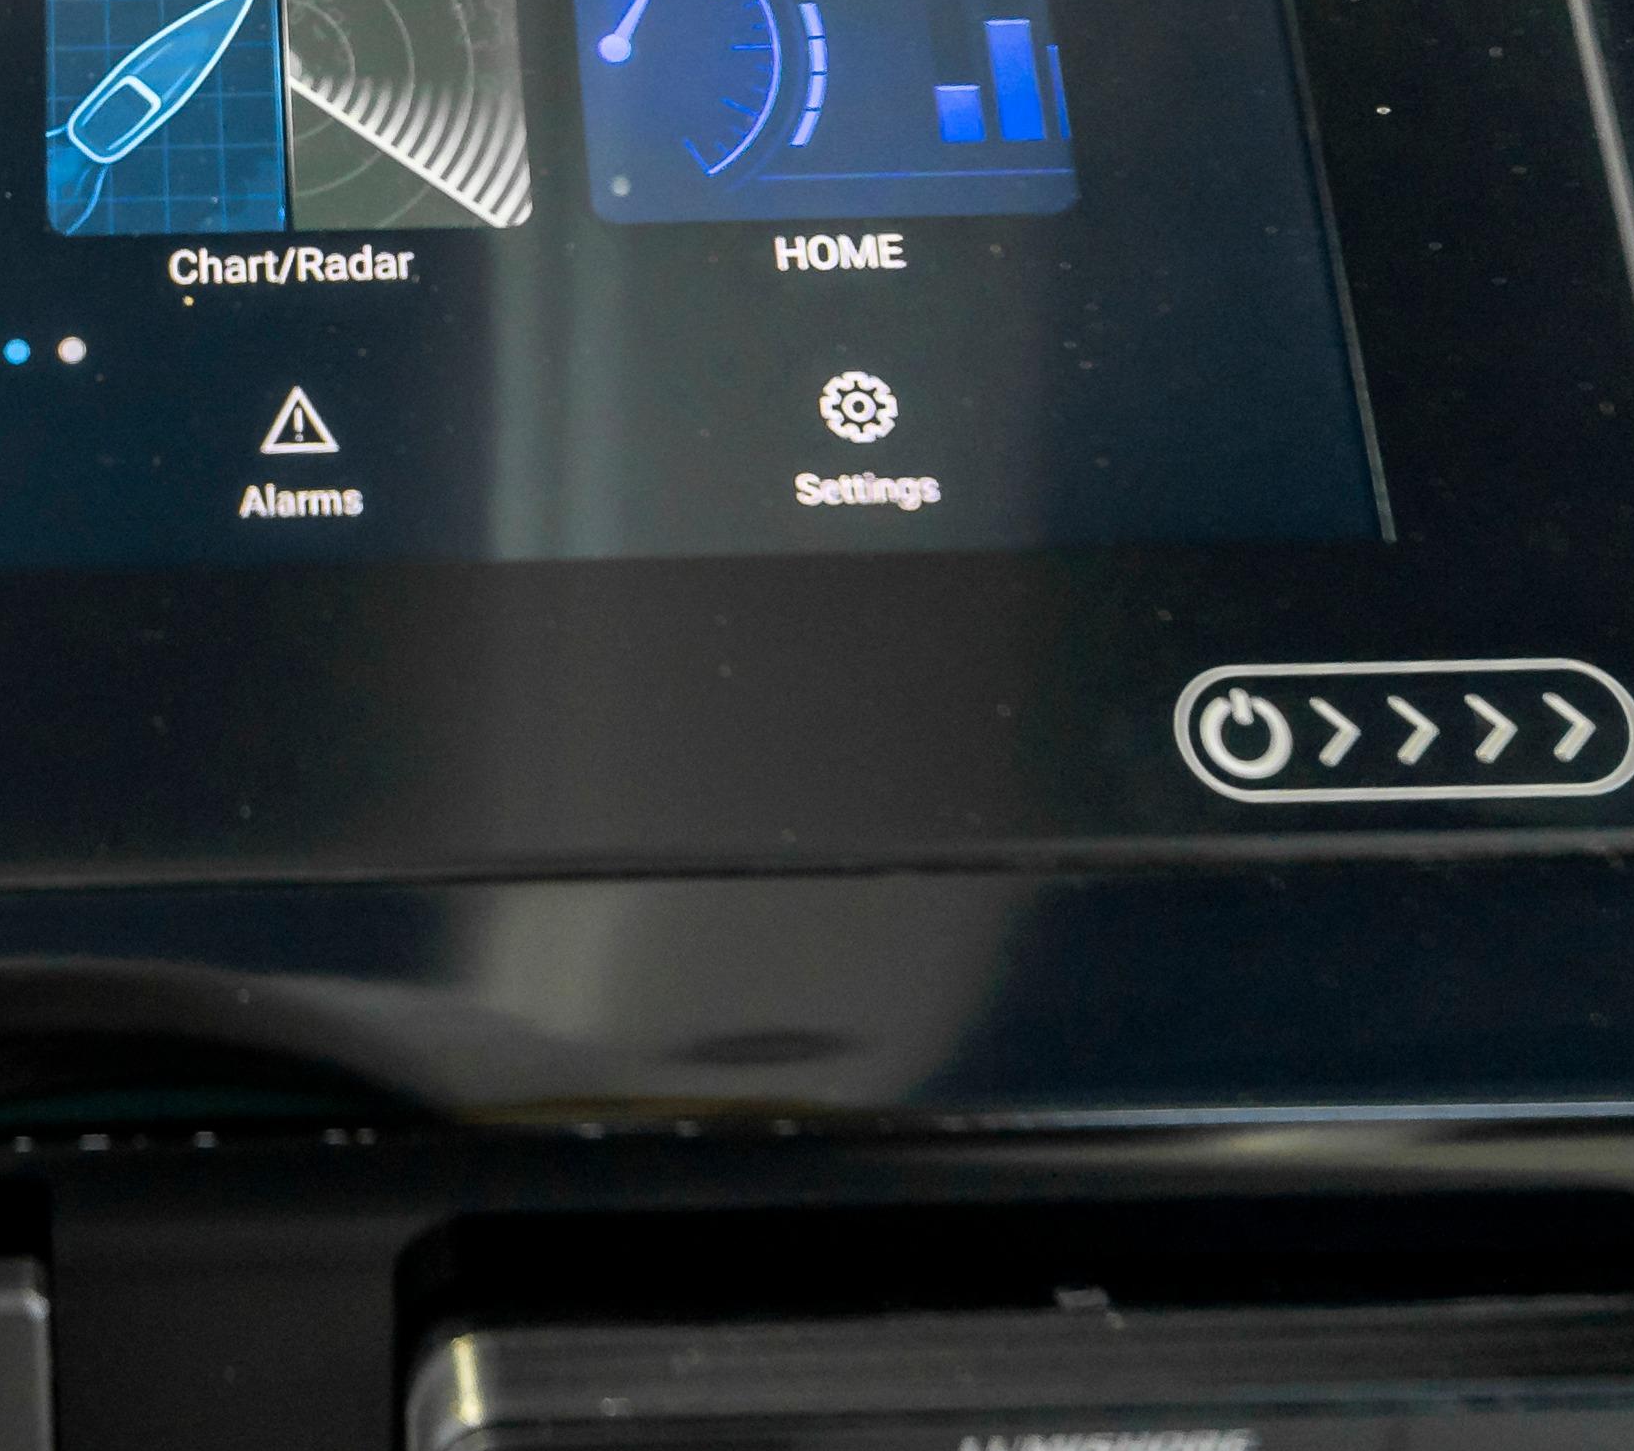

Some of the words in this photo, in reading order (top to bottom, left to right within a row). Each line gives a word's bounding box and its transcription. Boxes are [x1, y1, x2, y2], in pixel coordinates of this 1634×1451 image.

[168, 243, 415, 286] Chart/Radar
[774, 233, 907, 272] HOME
[239, 482, 364, 519] Alarms
[794, 471, 942, 511] Settings
